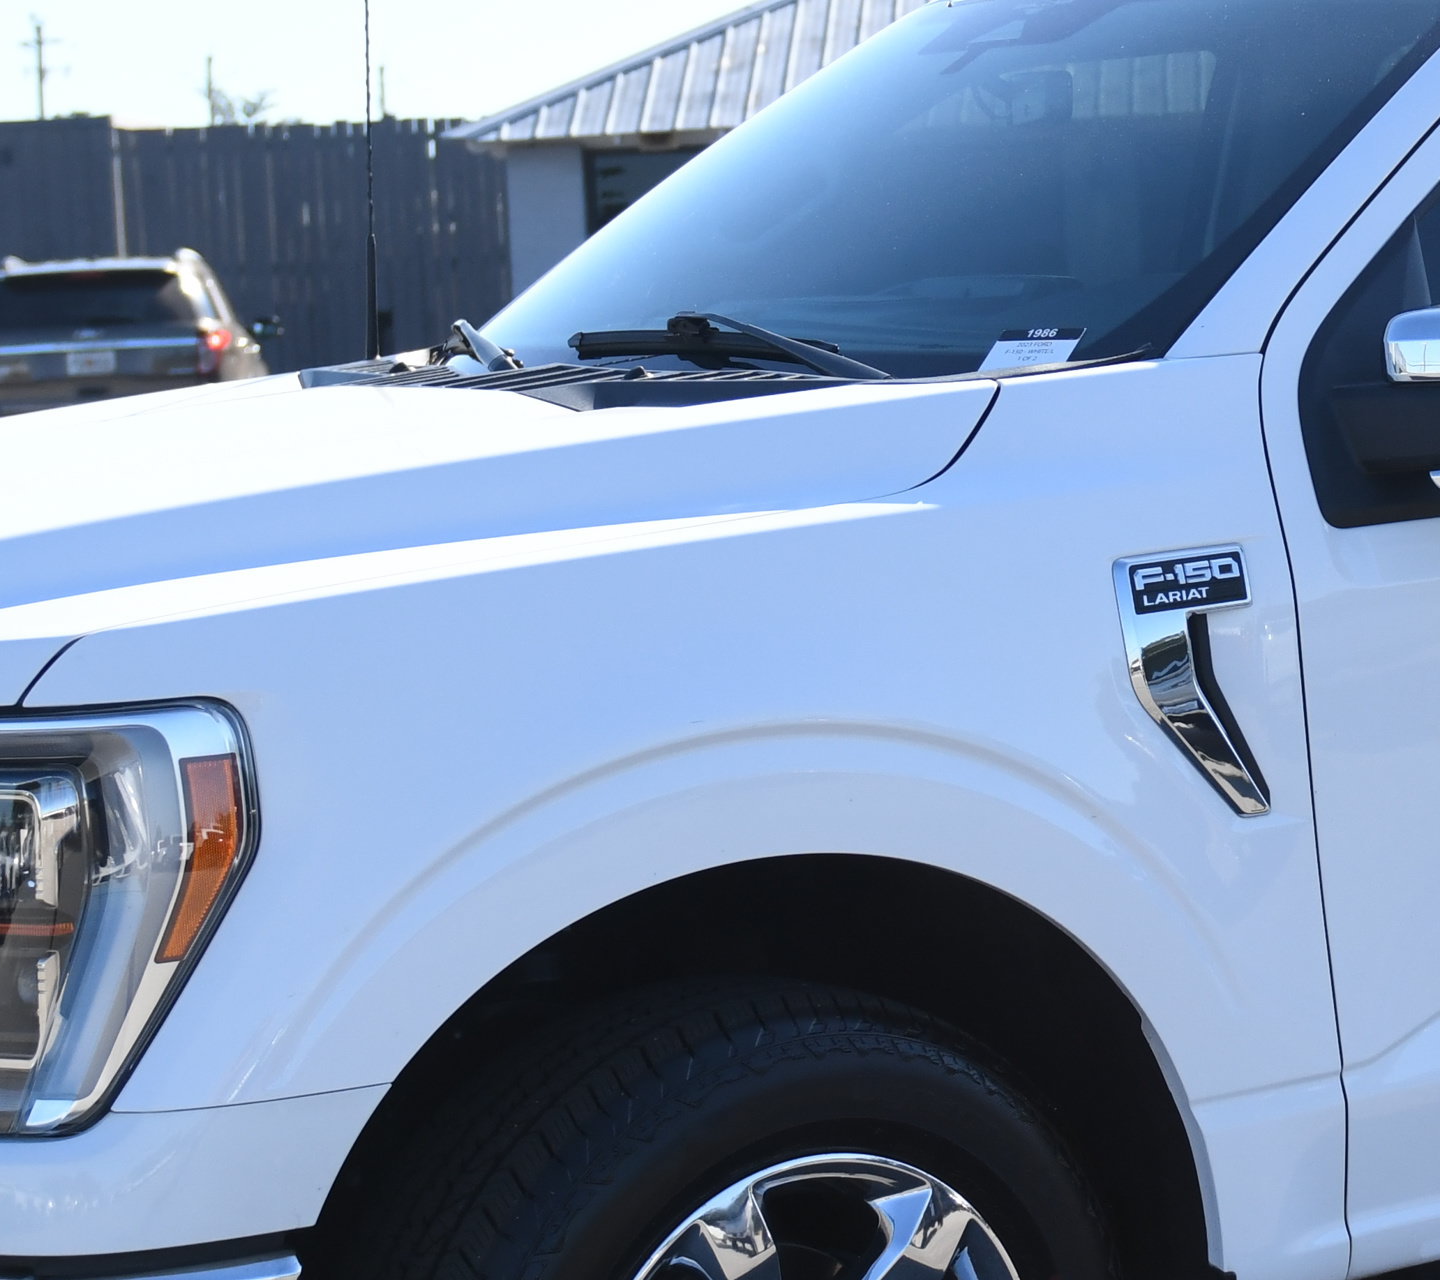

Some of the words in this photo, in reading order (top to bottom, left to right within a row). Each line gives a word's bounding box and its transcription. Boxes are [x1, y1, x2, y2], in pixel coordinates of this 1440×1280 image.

[1026, 328, 1059, 338] 1986
[1133, 556, 1241, 591] F-150
[1142, 586, 1210, 607] LARIAT
